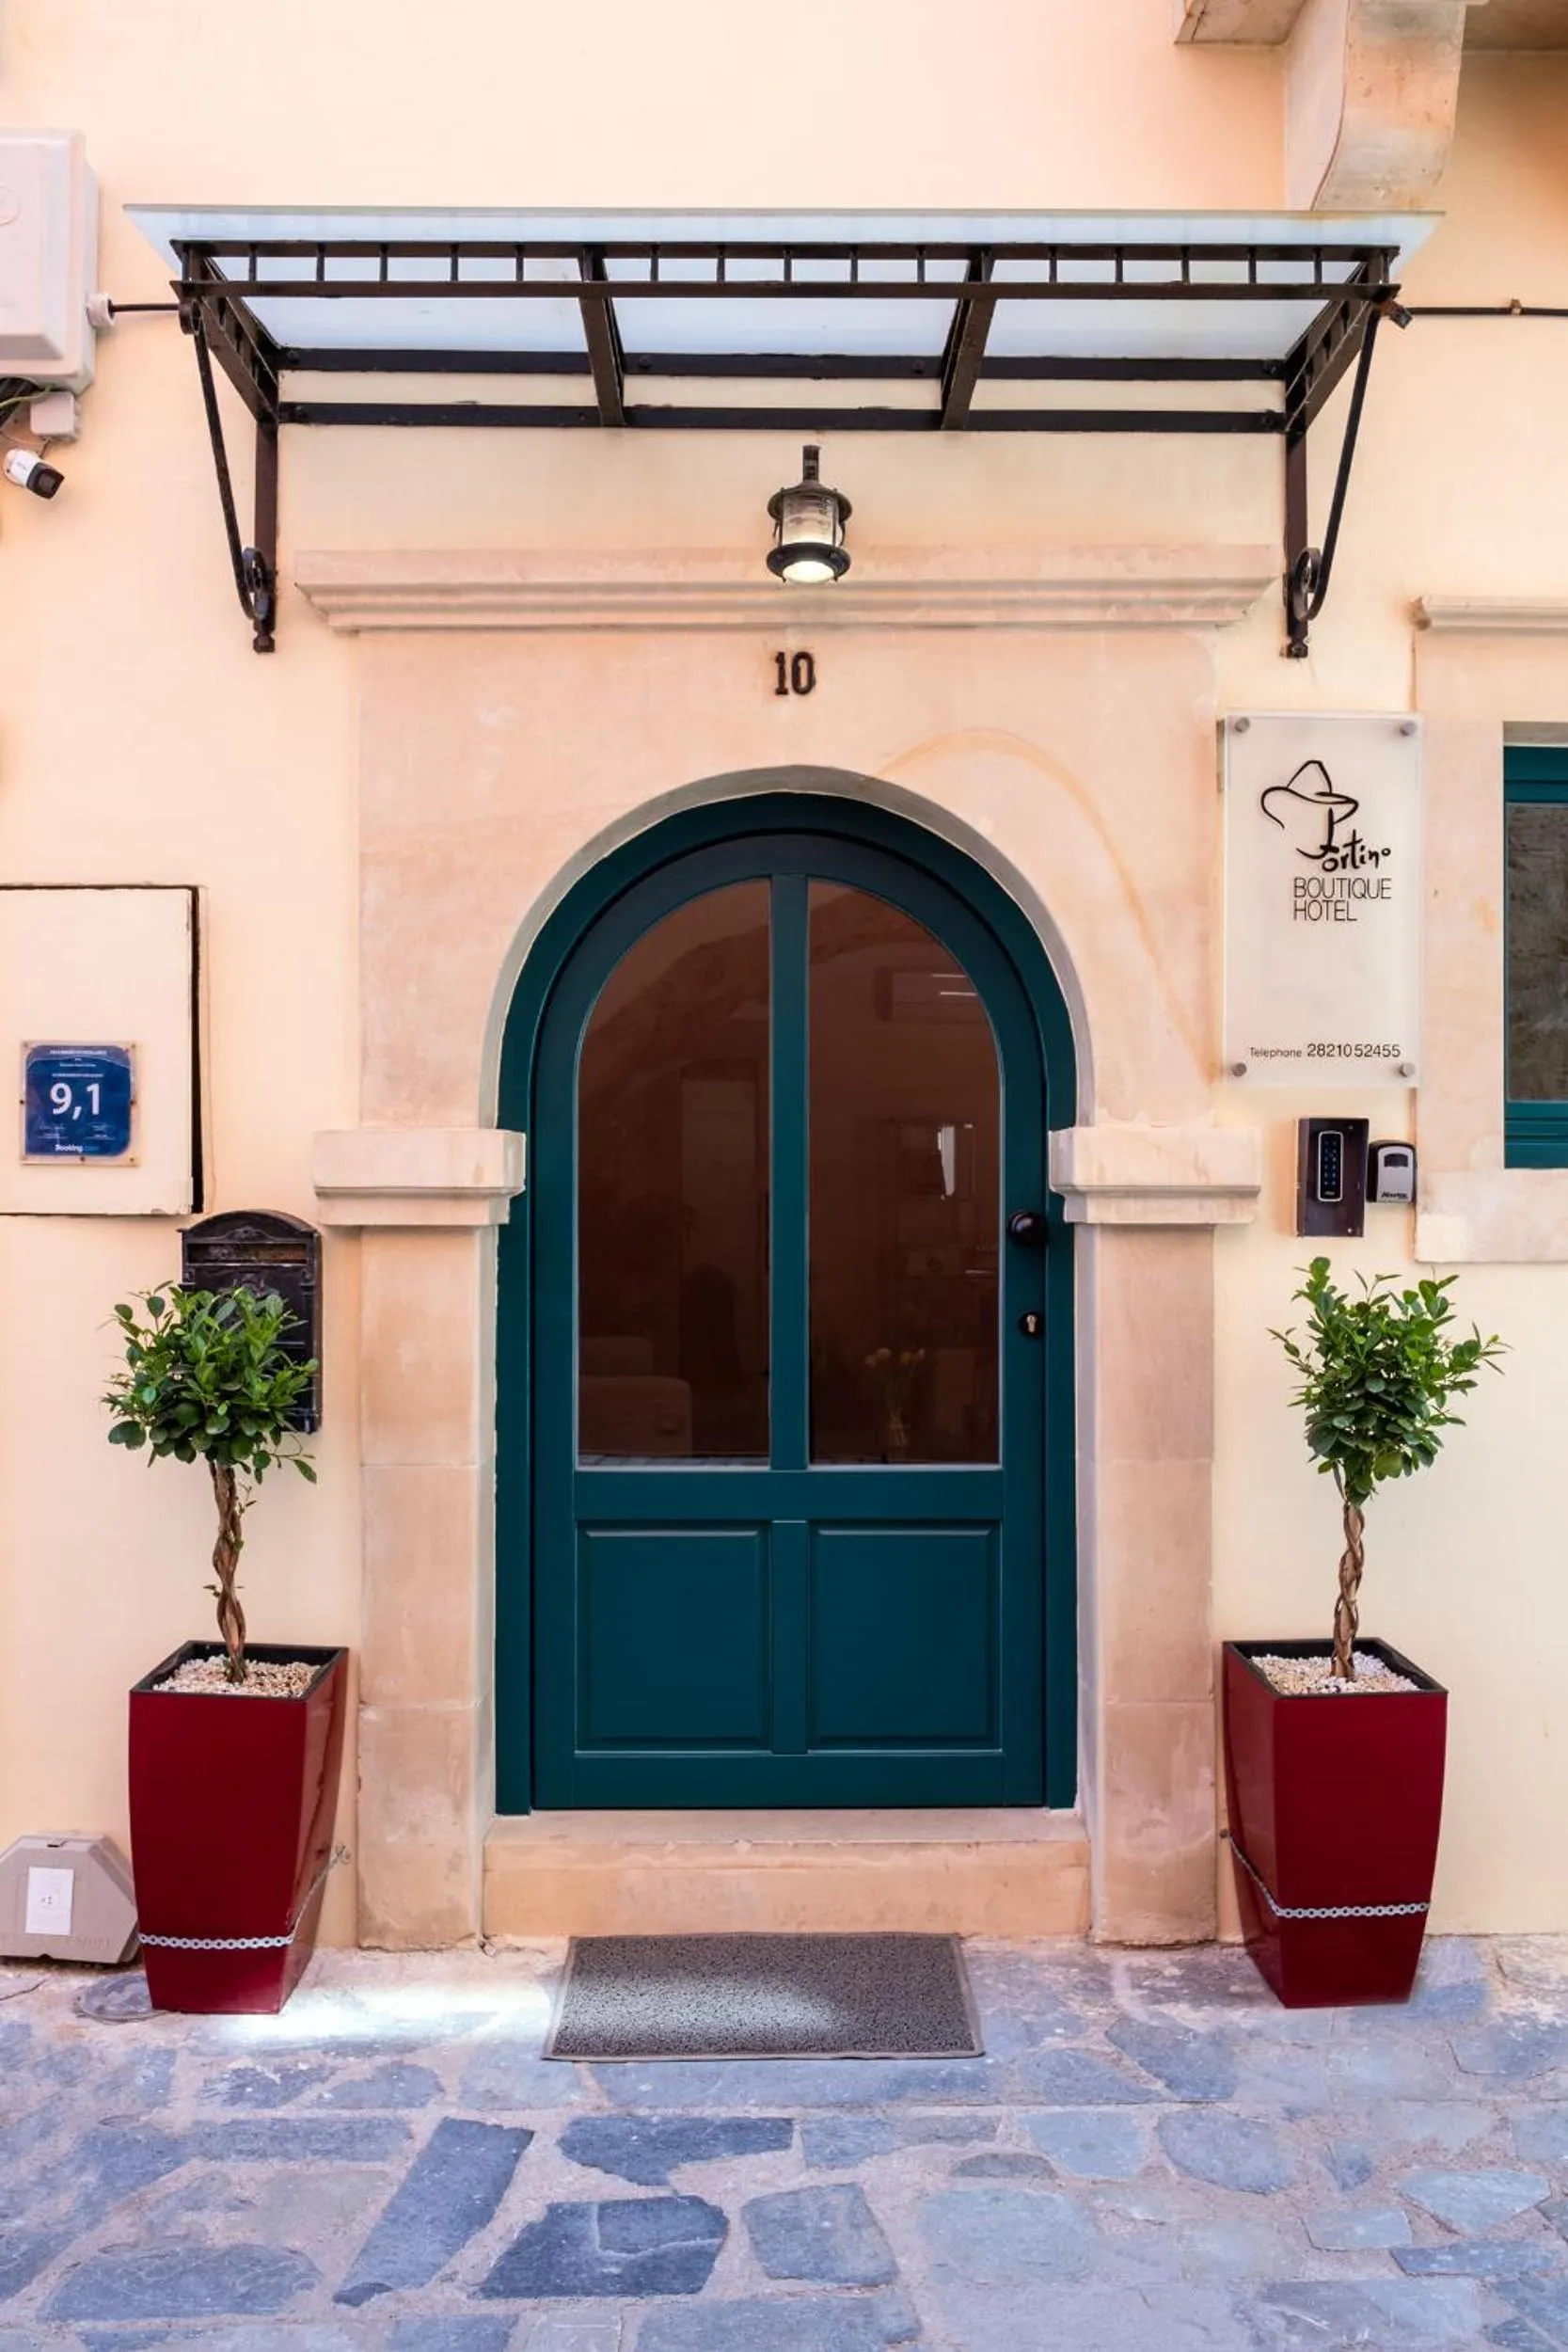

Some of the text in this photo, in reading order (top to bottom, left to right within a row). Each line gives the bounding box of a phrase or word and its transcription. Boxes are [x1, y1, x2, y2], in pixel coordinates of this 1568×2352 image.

[774, 651, 816, 695] 10
[1292, 877, 1392, 899] BOUTIQUE
[1292, 899, 1358, 921] HOTEL
[1249, 1046, 1303, 1058] Telephone
[50, 1082, 101, 1120] 9,1
